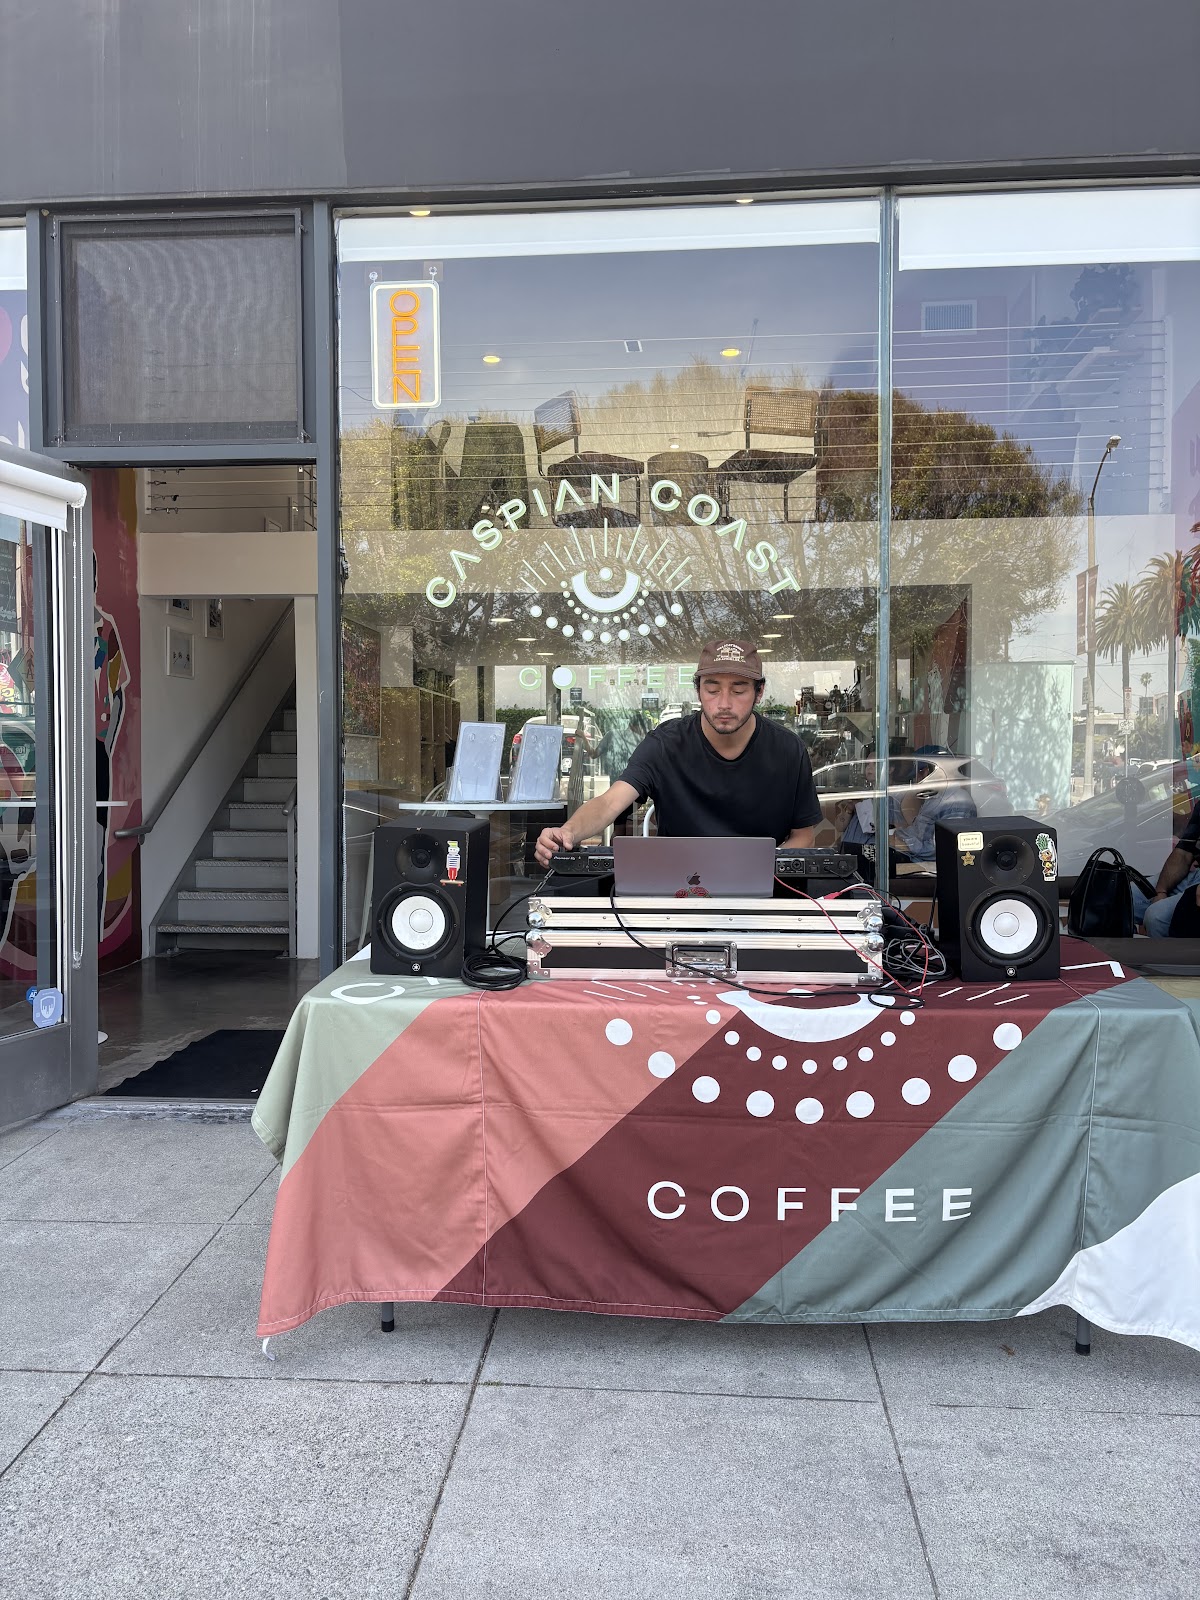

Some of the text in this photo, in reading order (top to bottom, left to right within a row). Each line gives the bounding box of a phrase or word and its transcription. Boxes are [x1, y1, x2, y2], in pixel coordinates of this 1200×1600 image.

[389, 290, 421, 405] OPEN
[425, 473, 802, 608] CASPIAN COAST
[518, 666, 697, 691] COFFEE
[647, 1181, 973, 1222] COFFEE
